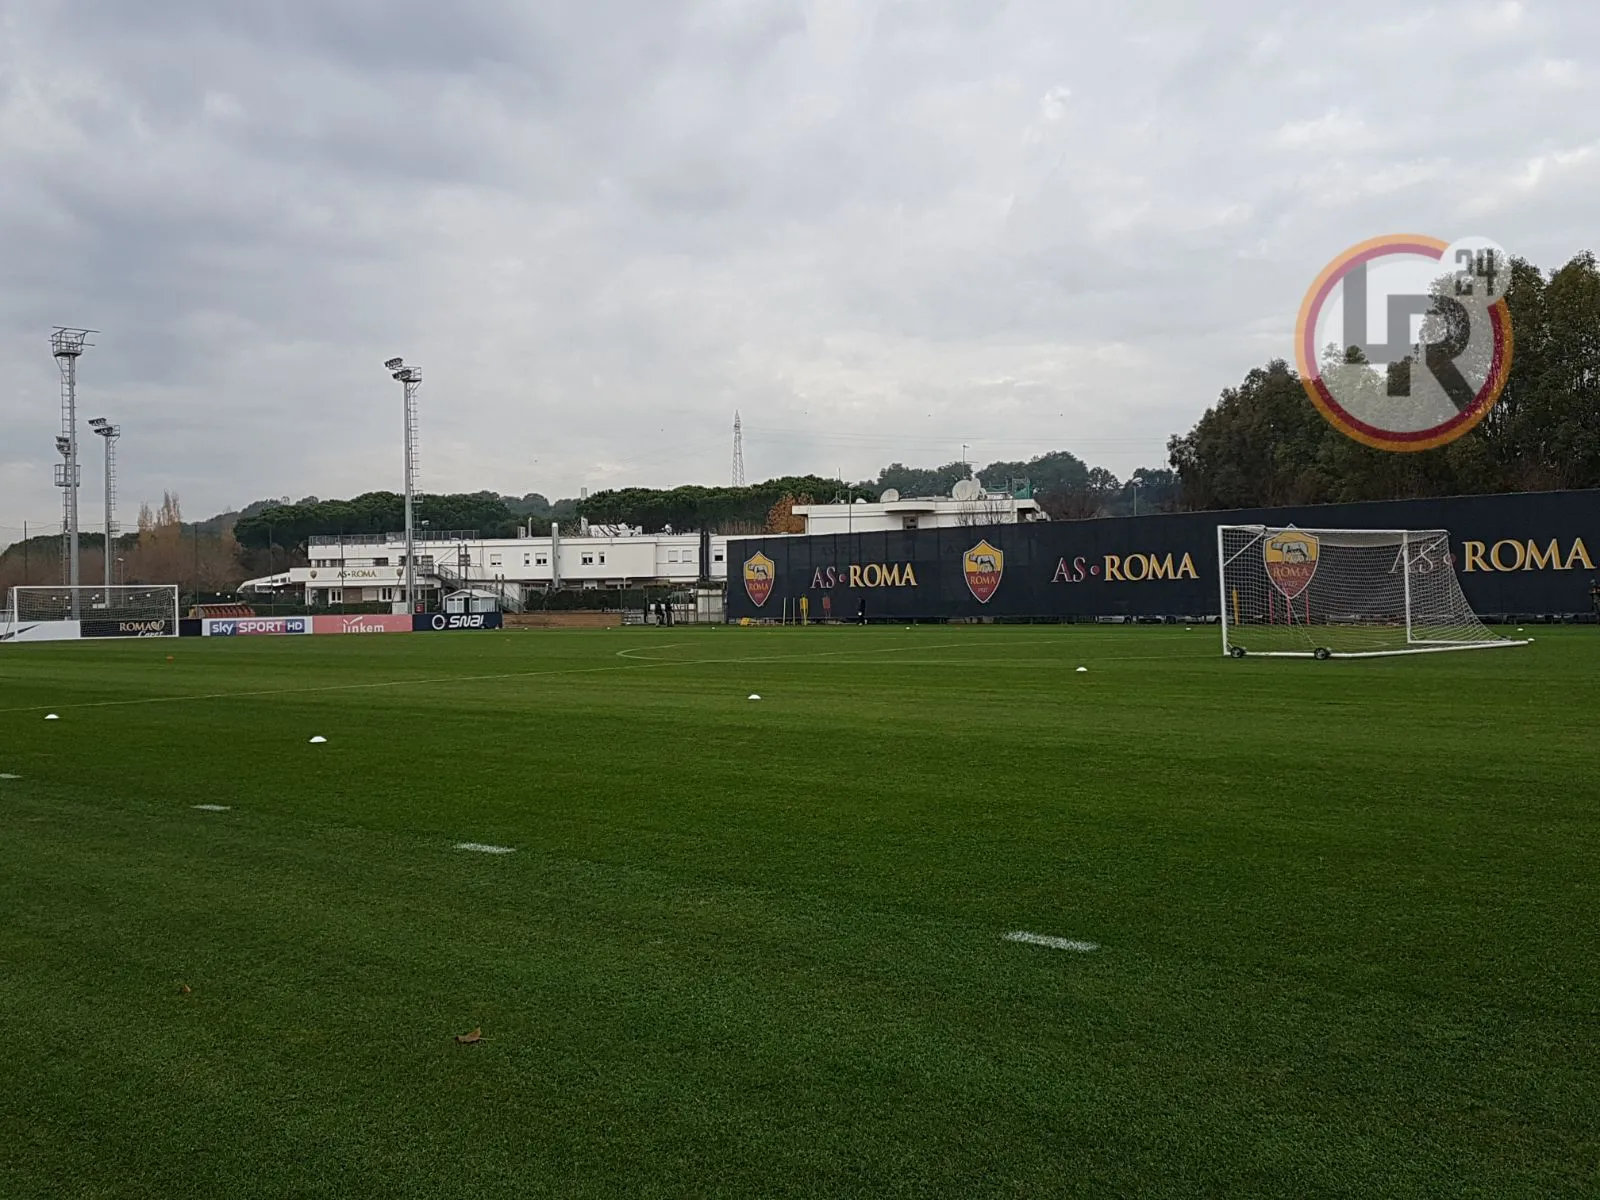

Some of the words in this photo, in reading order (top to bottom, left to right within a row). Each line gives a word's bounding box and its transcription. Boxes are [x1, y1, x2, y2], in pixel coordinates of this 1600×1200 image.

[1461, 536, 1597, 573] ROMA
[1103, 552, 1200, 582] ROMA
[848, 562, 918, 588] ROMA
[970, 576, 996, 585] ROMA
[748, 583, 769, 591] ROMA
[119, 622, 153, 632] ROMA
[212, 622, 234, 635] sky
[238, 621, 282, 633] SPORT
[287, 621, 303, 631] HD
